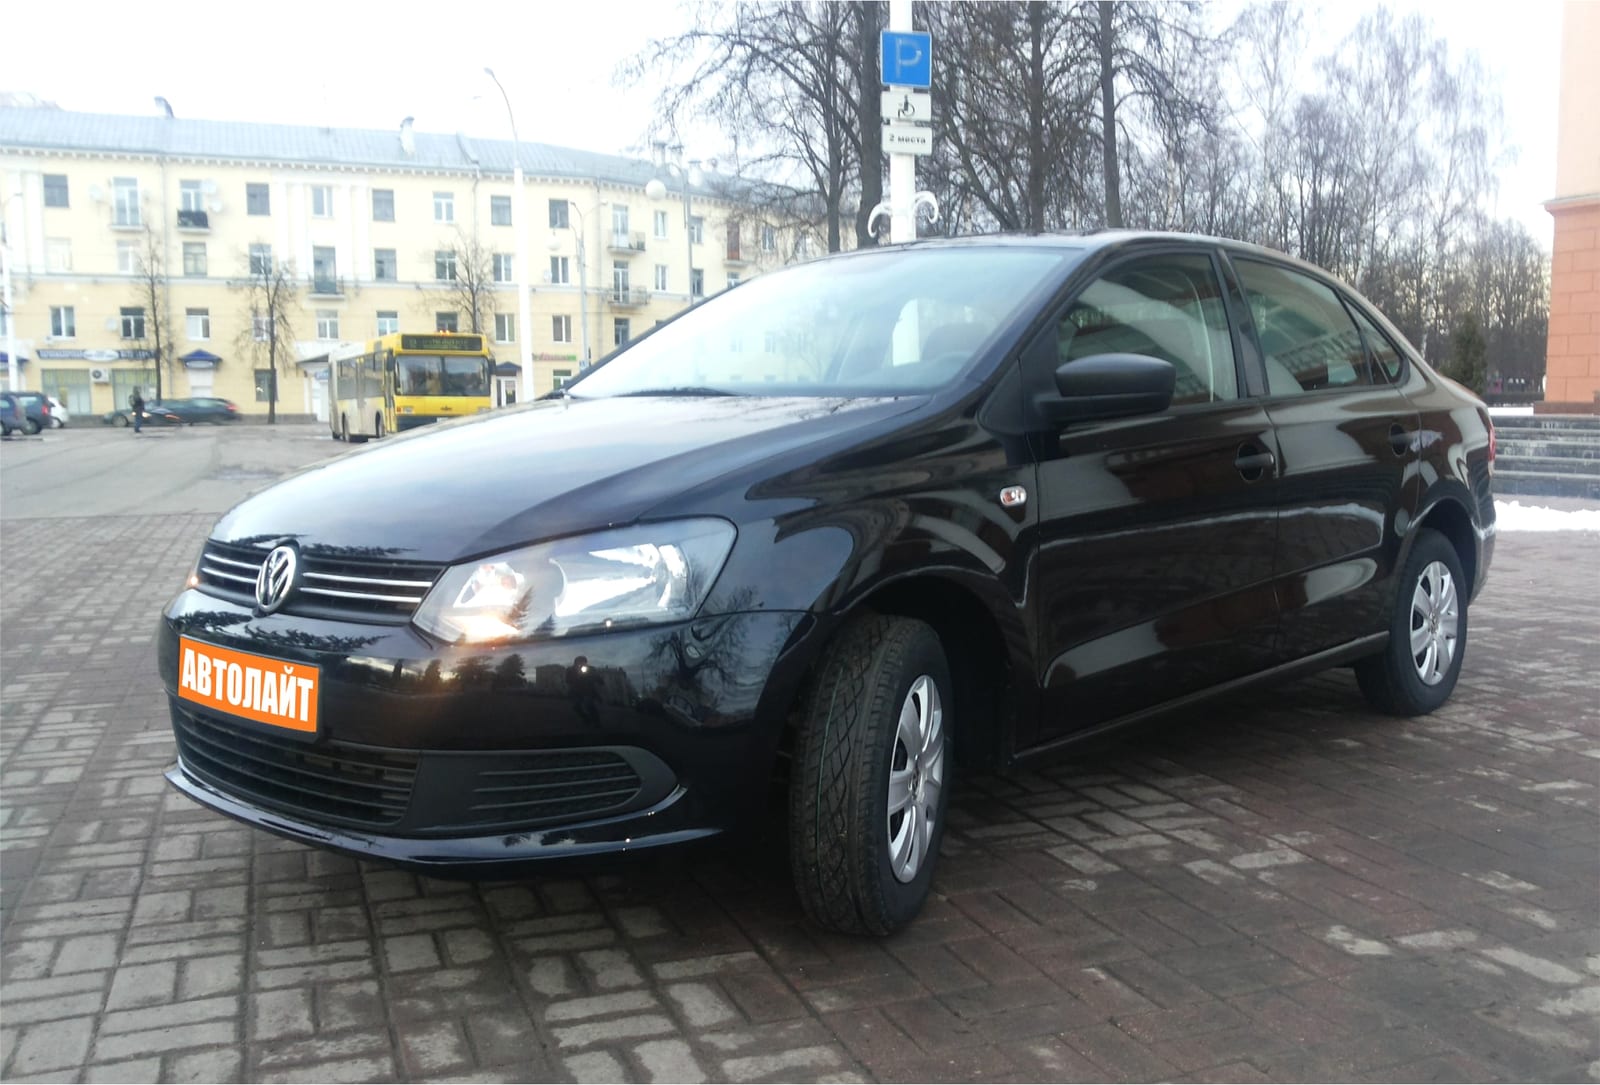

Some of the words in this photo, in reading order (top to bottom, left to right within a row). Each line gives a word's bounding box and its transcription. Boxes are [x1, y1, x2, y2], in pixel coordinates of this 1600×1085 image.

[895, 37, 922, 80] P
[889, 133, 895, 142] 2
[897, 136, 926, 144] места
